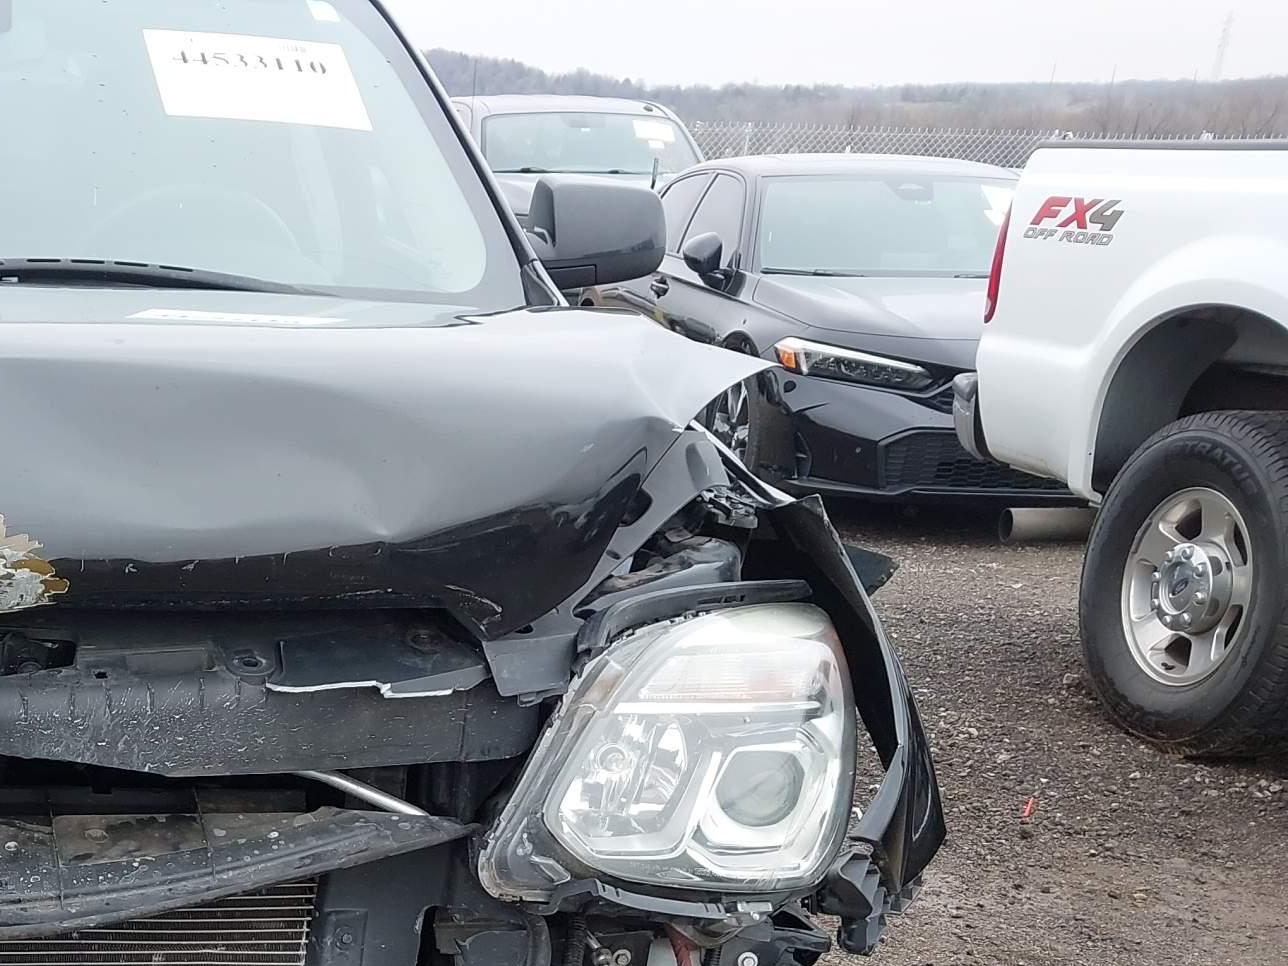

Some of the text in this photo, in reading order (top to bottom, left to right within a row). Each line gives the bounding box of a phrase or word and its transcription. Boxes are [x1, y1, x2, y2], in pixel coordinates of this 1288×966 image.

[173, 50, 328, 75] 44533110
[1030, 196, 1125, 232] FX4
[1023, 226, 1114, 246] OFF ROAD
